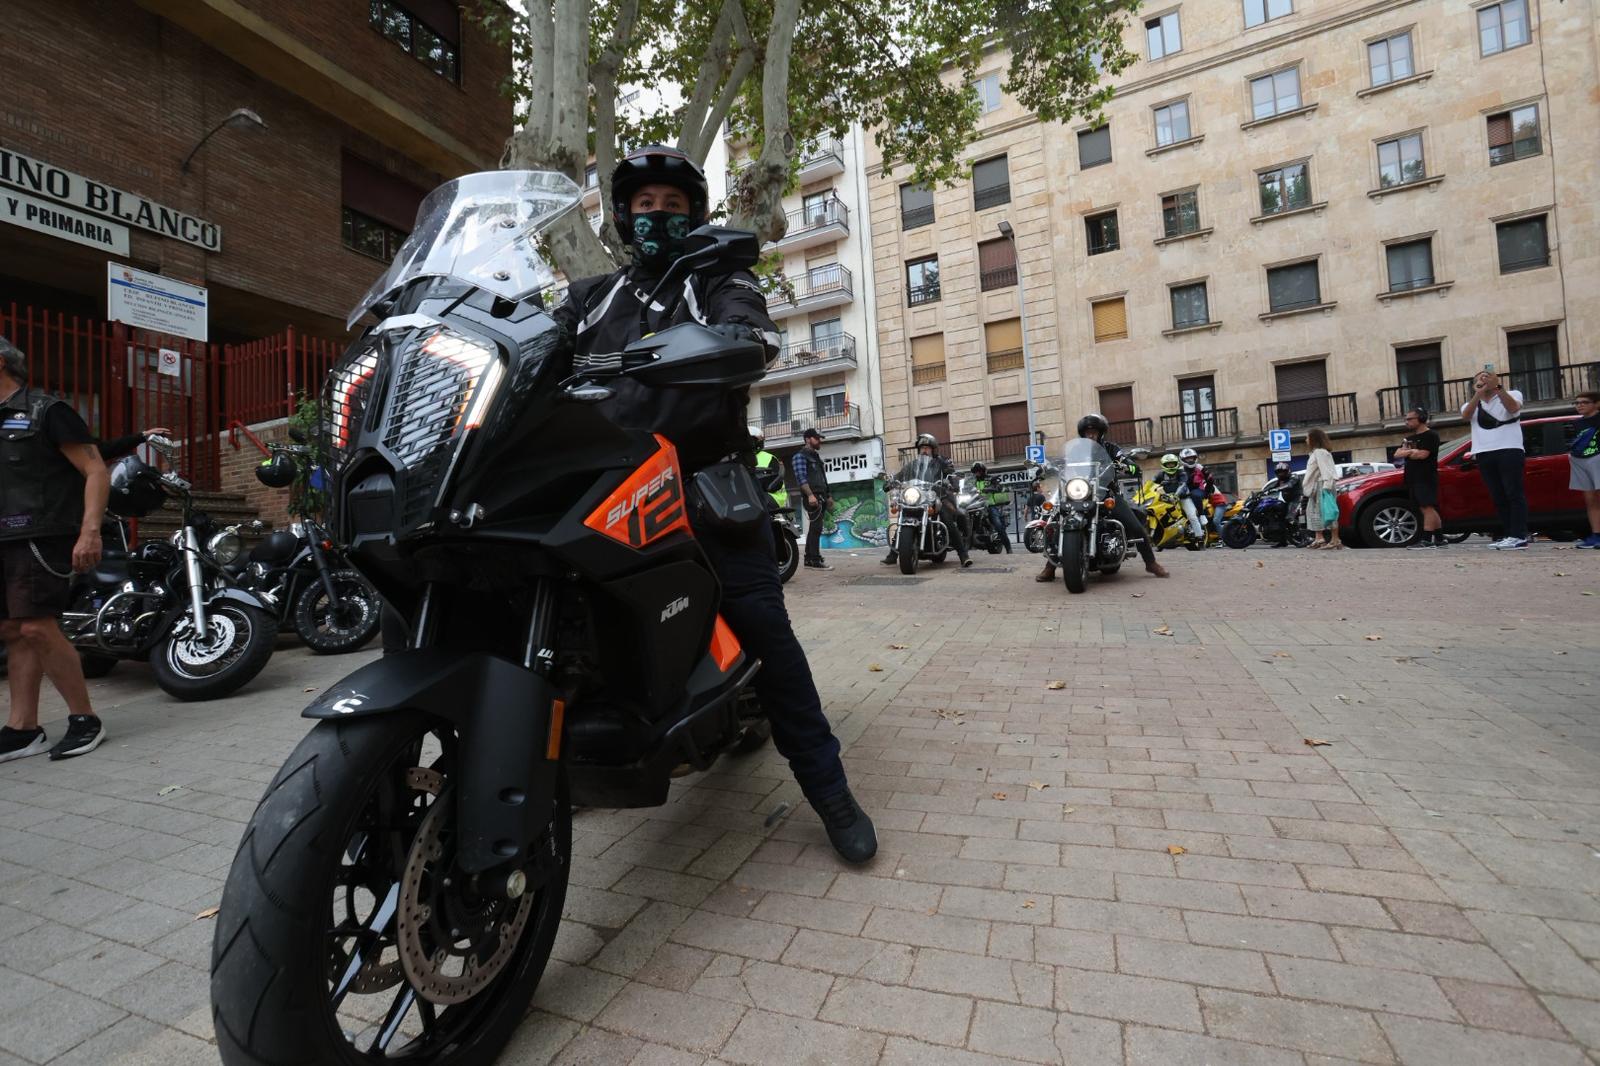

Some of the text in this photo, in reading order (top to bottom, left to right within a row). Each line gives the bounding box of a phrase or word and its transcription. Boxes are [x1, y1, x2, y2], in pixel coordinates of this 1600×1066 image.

[7, 197, 113, 246] Y PRIMARIA
[85, 180, 218, 249] BLANCO
[1029, 448, 1041, 463] P
[1274, 433, 1286, 450] P
[605, 466, 675, 530] SUPER
[627, 475, 684, 546] 12
[660, 596, 689, 624] KTM
